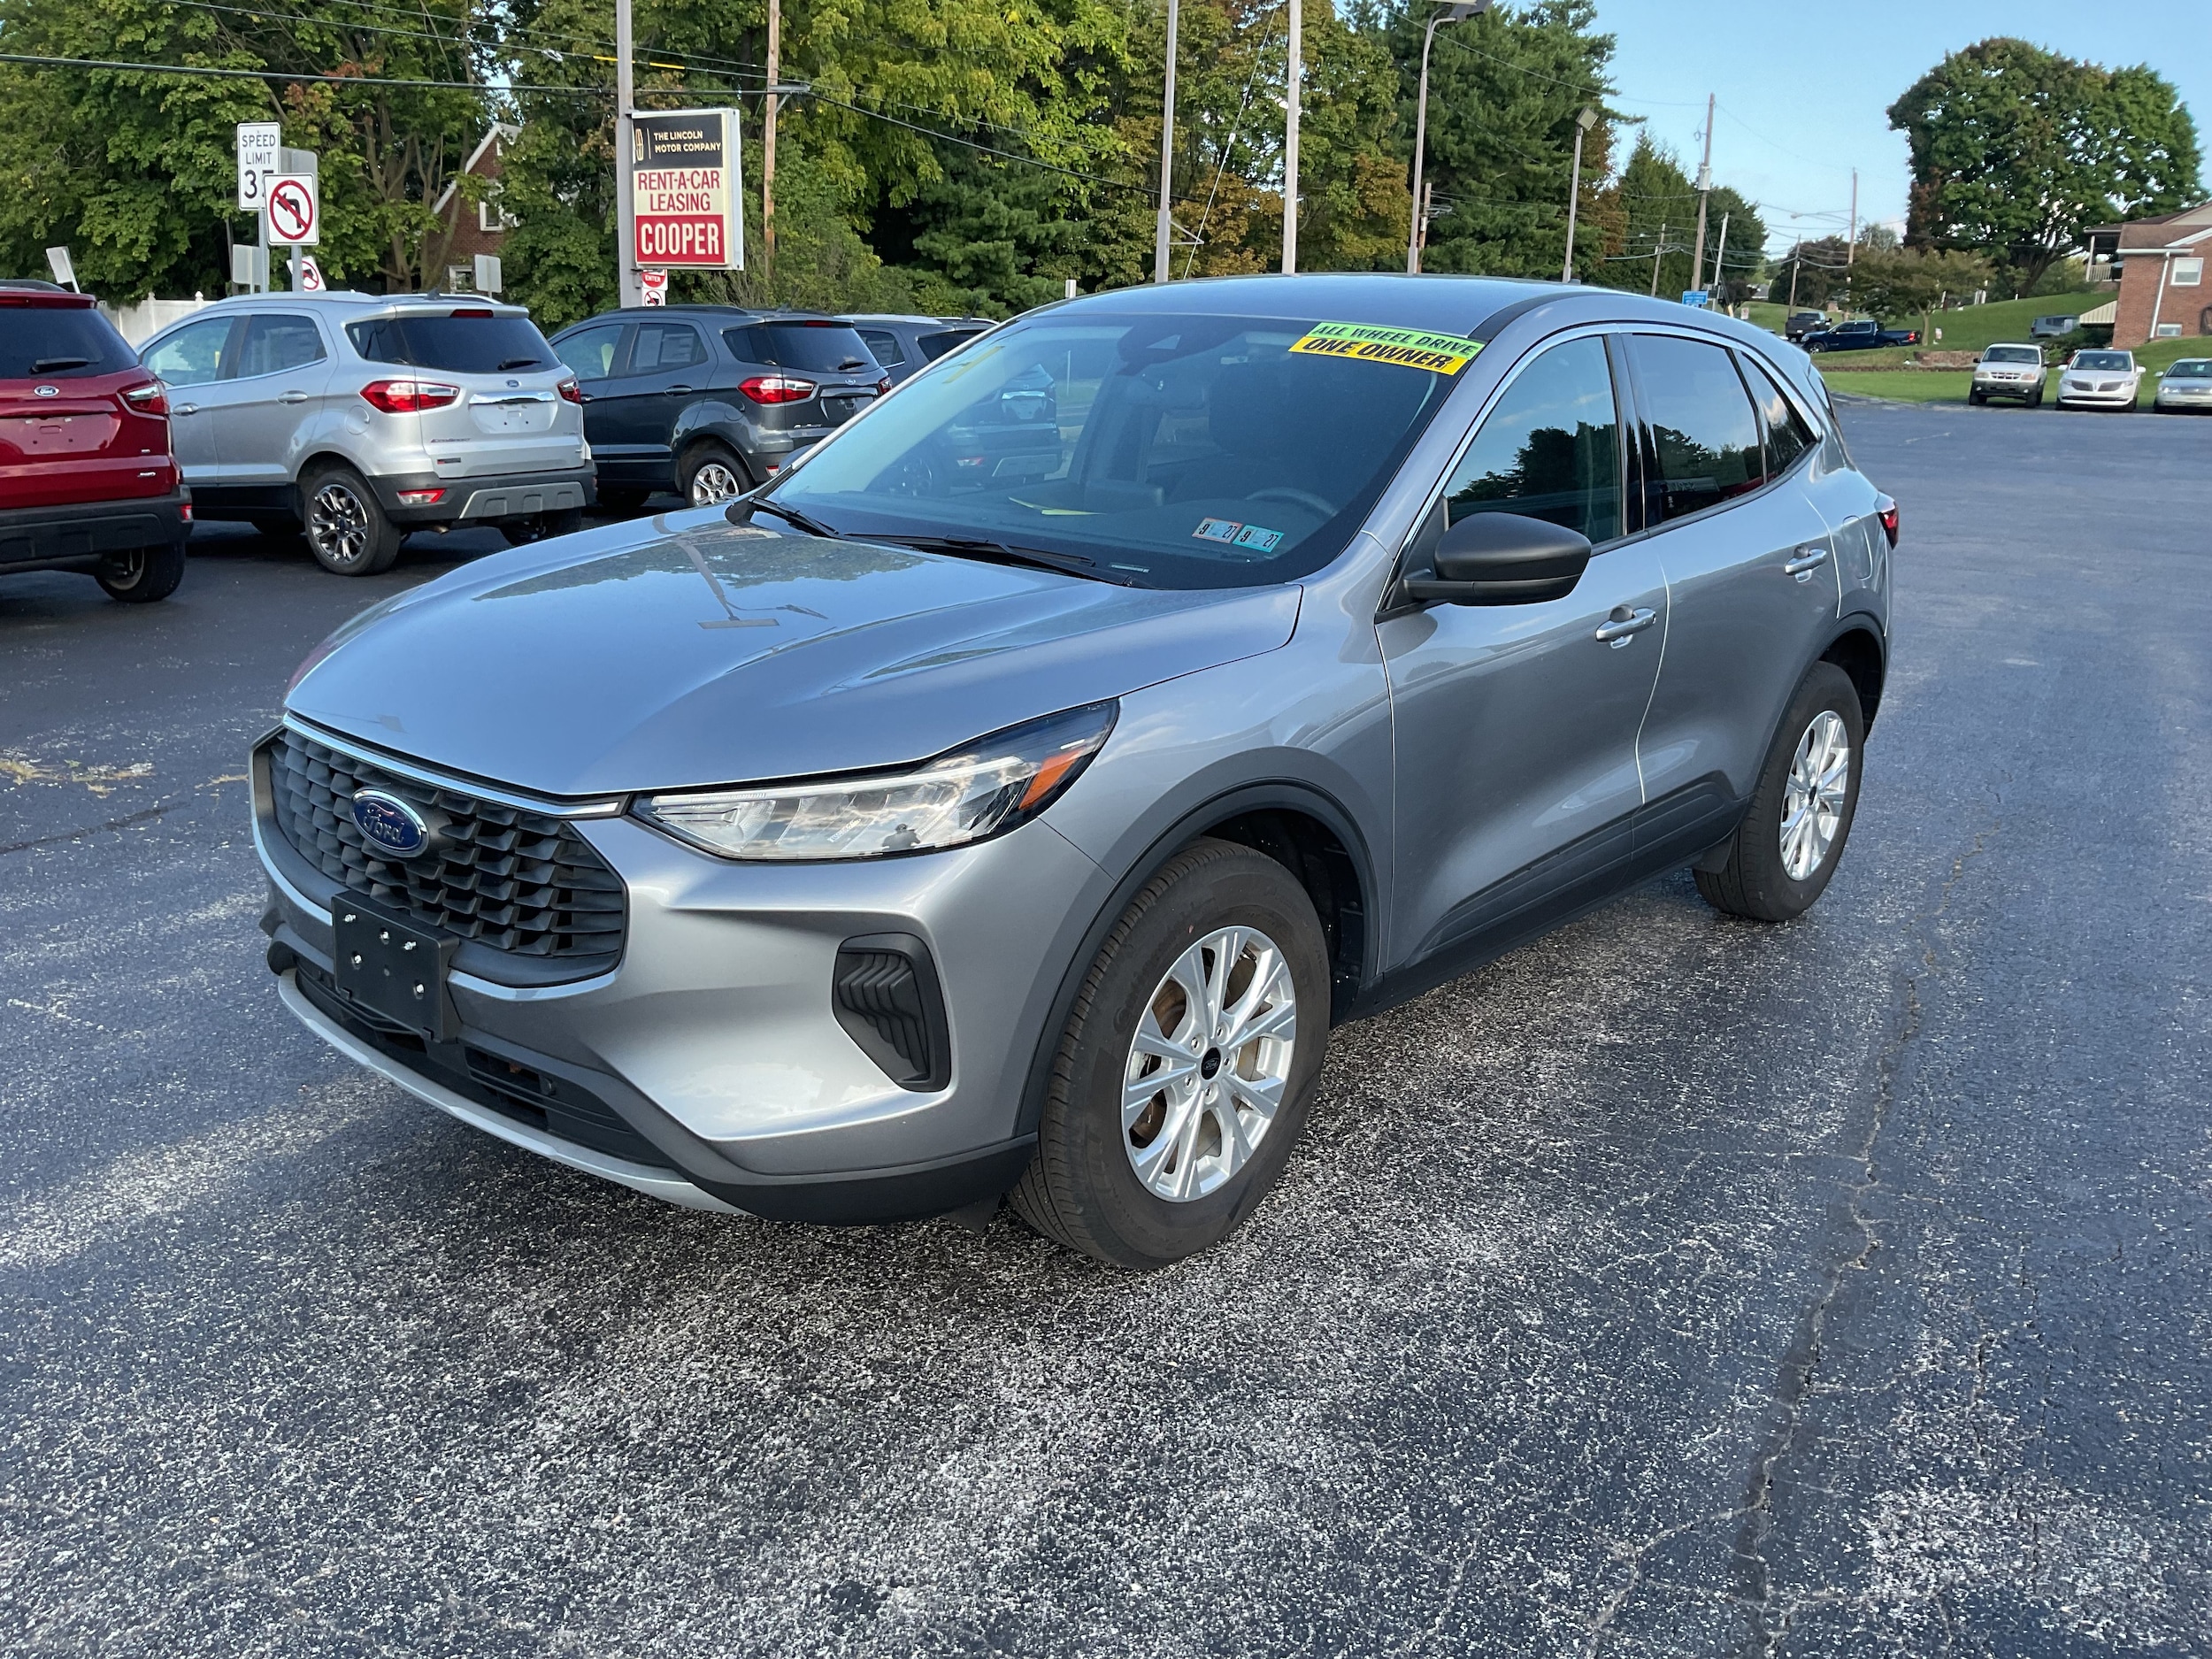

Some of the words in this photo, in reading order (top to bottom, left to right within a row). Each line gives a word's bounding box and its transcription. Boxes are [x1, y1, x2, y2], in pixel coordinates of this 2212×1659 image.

[242, 134, 276, 147] SPEED
[653, 132, 669, 142] THE
[669, 130, 703, 141] LINCOLN
[655, 143, 682, 154] MOTOR
[683, 142, 722, 152] COMPANY
[246, 151, 272, 165] LIMIT
[243, 169, 274, 199] 3
[638, 170, 720, 191] RENT-A-CAR
[649, 192, 710, 211] LEASING
[641, 222, 720, 256] COOPER
[1311, 325, 1345, 336] ALL
[1349, 327, 1411, 344] WHEEL
[1414, 335, 1479, 357] DRIVE
[1302, 337, 1357, 354] ONE
[1356, 342, 1455, 370] OWNER
[1222, 525, 1239, 539] 27
[1263, 534, 1279, 549] 27
[363, 802, 406, 844] Ford
